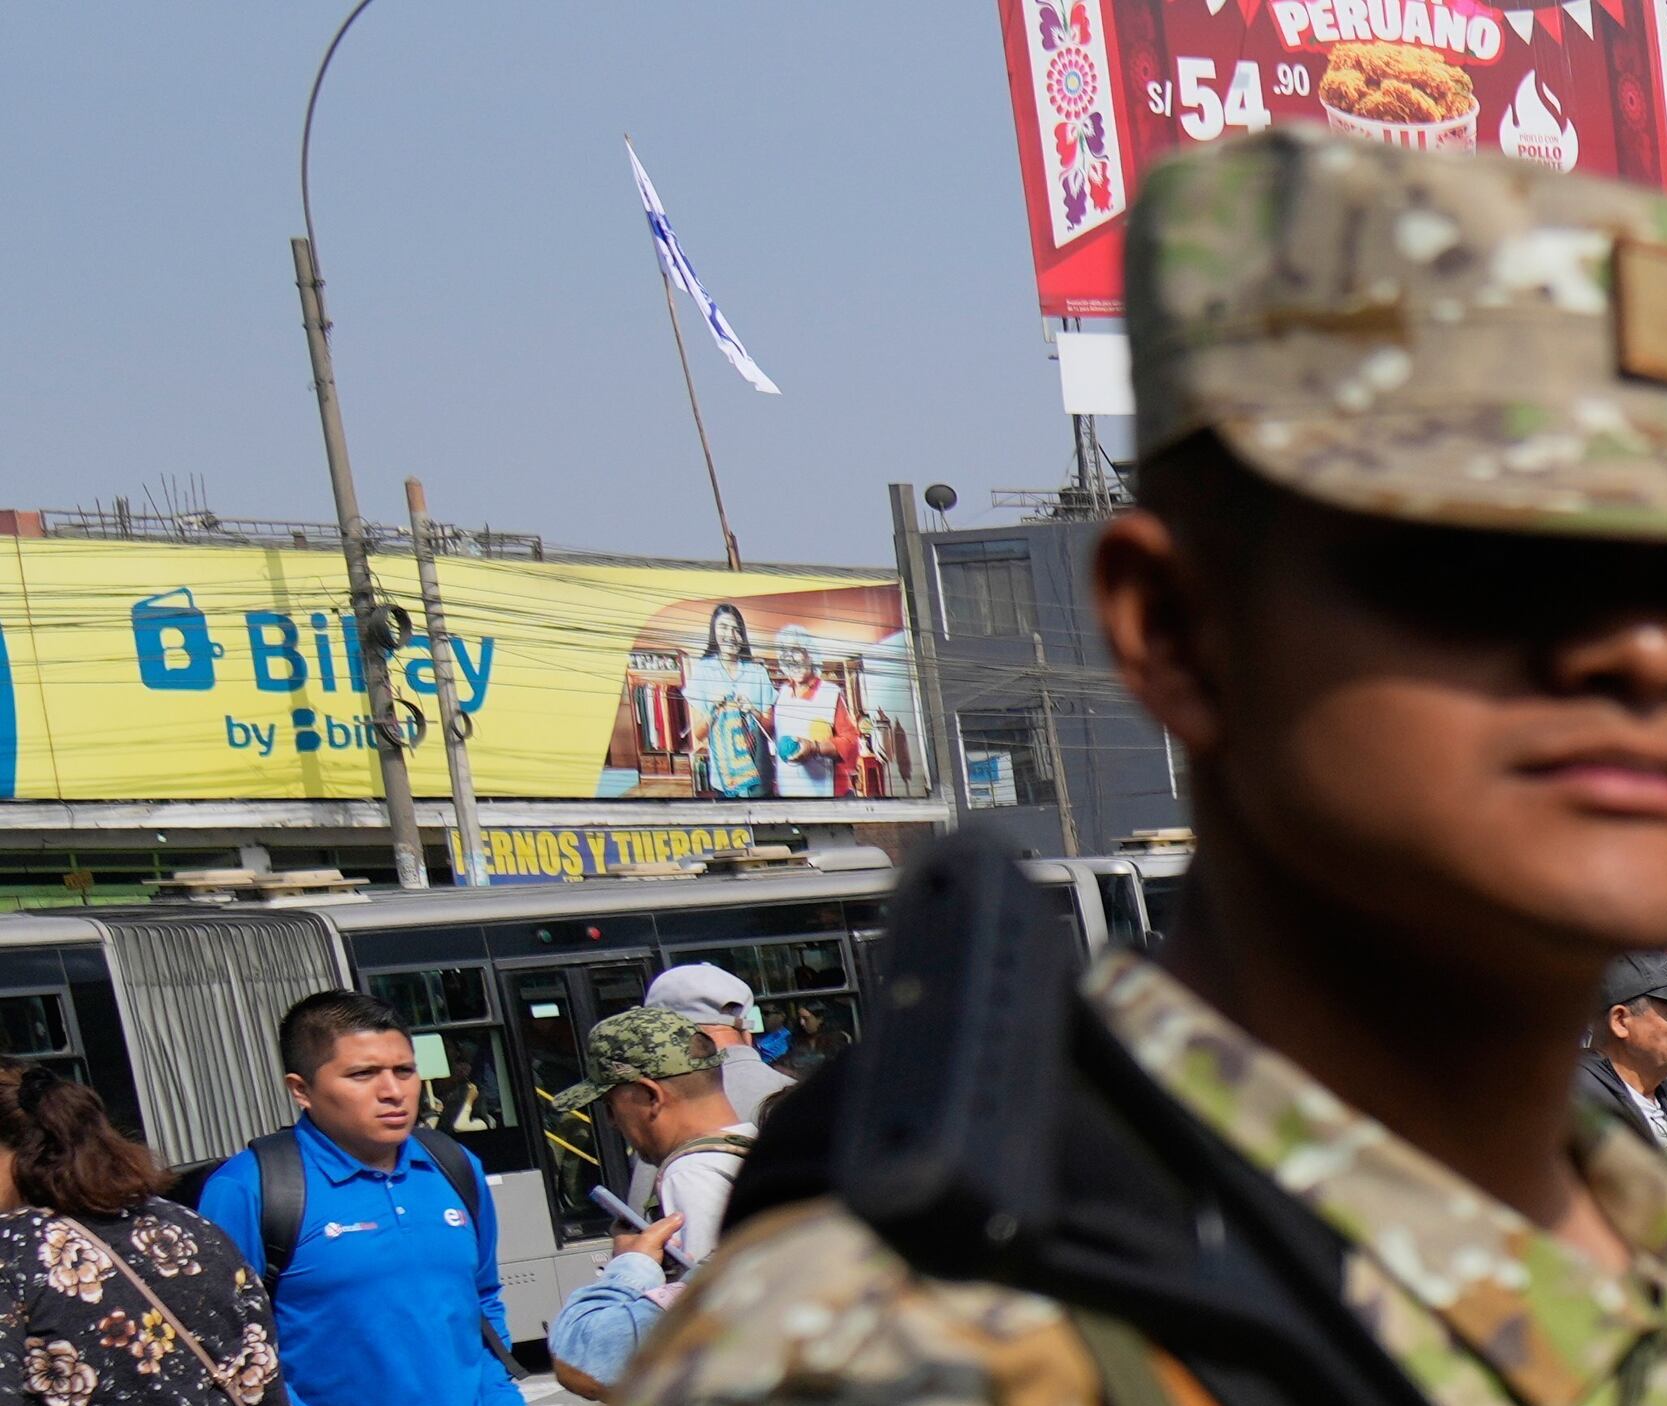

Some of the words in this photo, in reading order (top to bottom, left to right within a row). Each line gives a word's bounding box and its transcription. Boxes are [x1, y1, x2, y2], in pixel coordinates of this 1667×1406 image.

[1273, 0, 1500, 60] PERUANO
[1517, 144, 1562, 160] POLLO
[225, 715, 276, 757] by
[585, 832, 608, 874] Y
